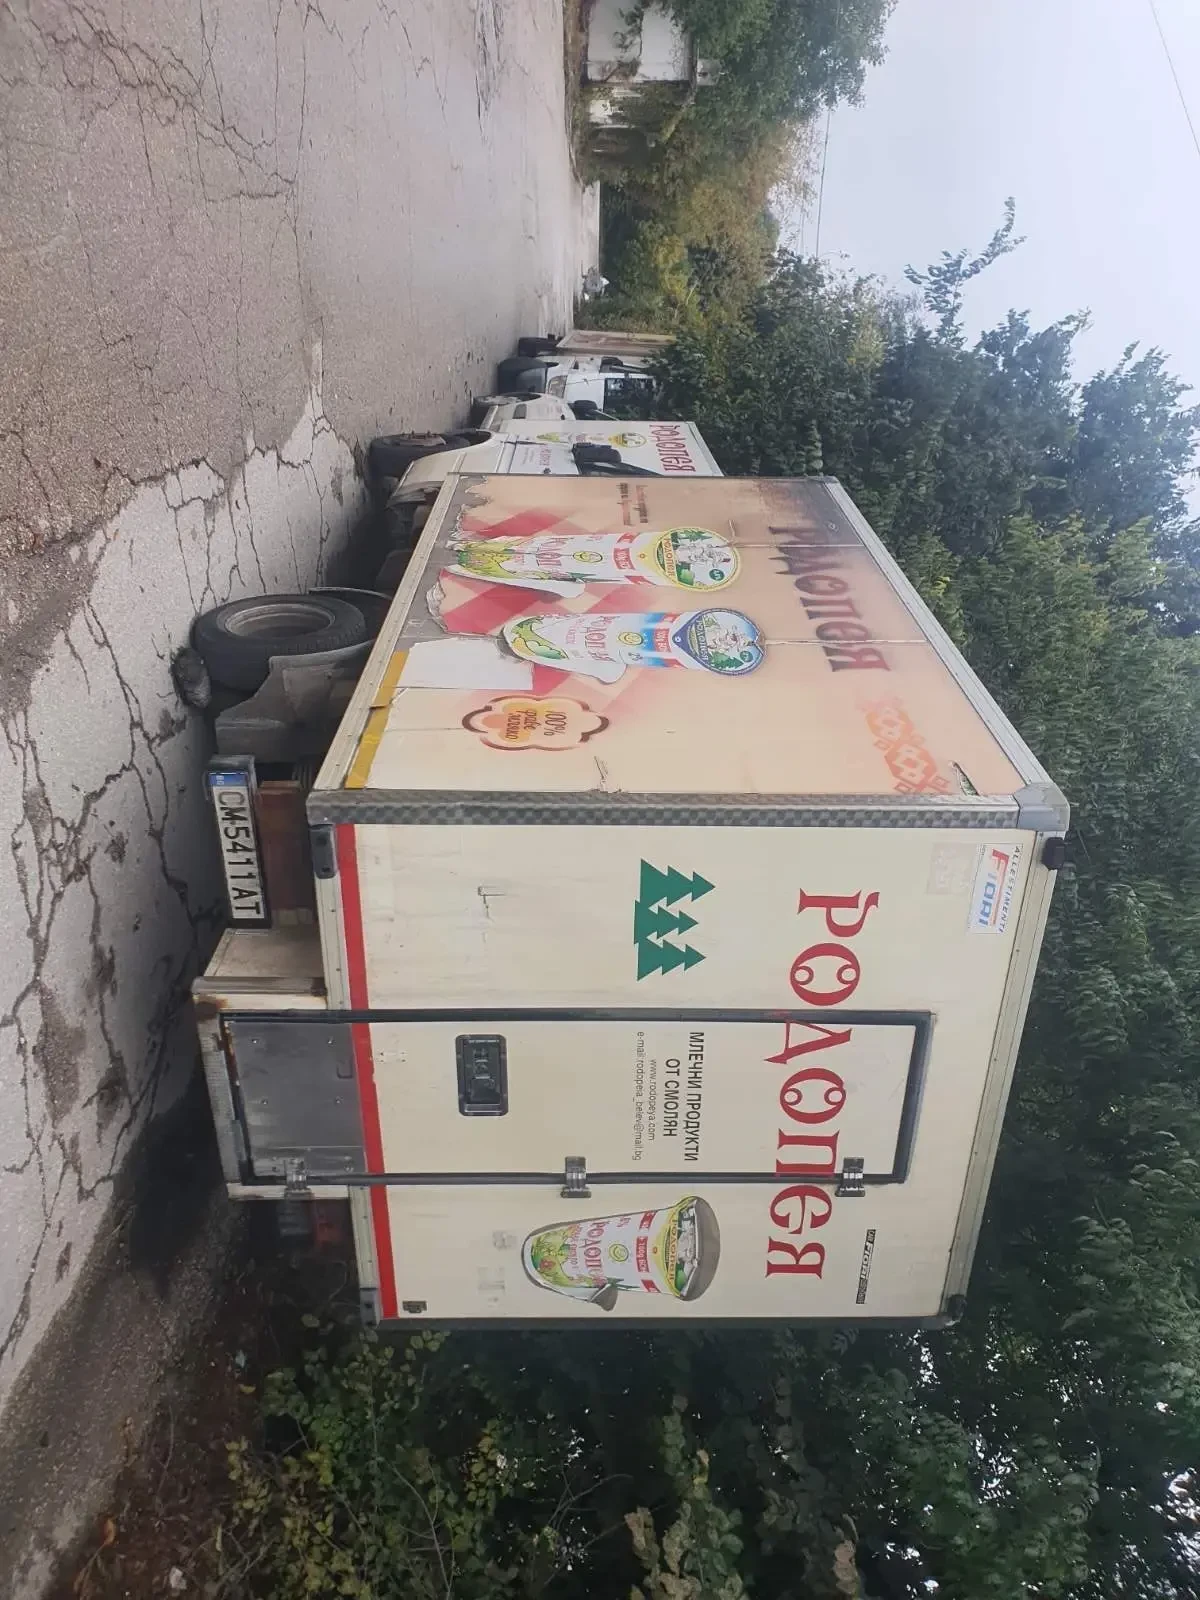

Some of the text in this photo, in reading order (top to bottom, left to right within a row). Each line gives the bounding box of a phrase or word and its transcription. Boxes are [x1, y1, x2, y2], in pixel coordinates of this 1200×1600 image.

[648, 425, 697, 473] РОДОПЕЯ
[768, 526, 892, 673] РОДОПЕЯ
[543, 710, 567, 736] 100%
[978, 849, 1010, 926] FIORI
[998, 845, 1020, 933] ALLESTIMENTI
[646, 1058, 658, 1141] www.rodopeya.com
[663, 1058, 681, 1137] ОТ СМОЛЯН
[682, 1031, 705, 1161] МЛЕЧНИ ПРОДУКТИ
[764, 887, 880, 1280] РОДОПЕЯ
